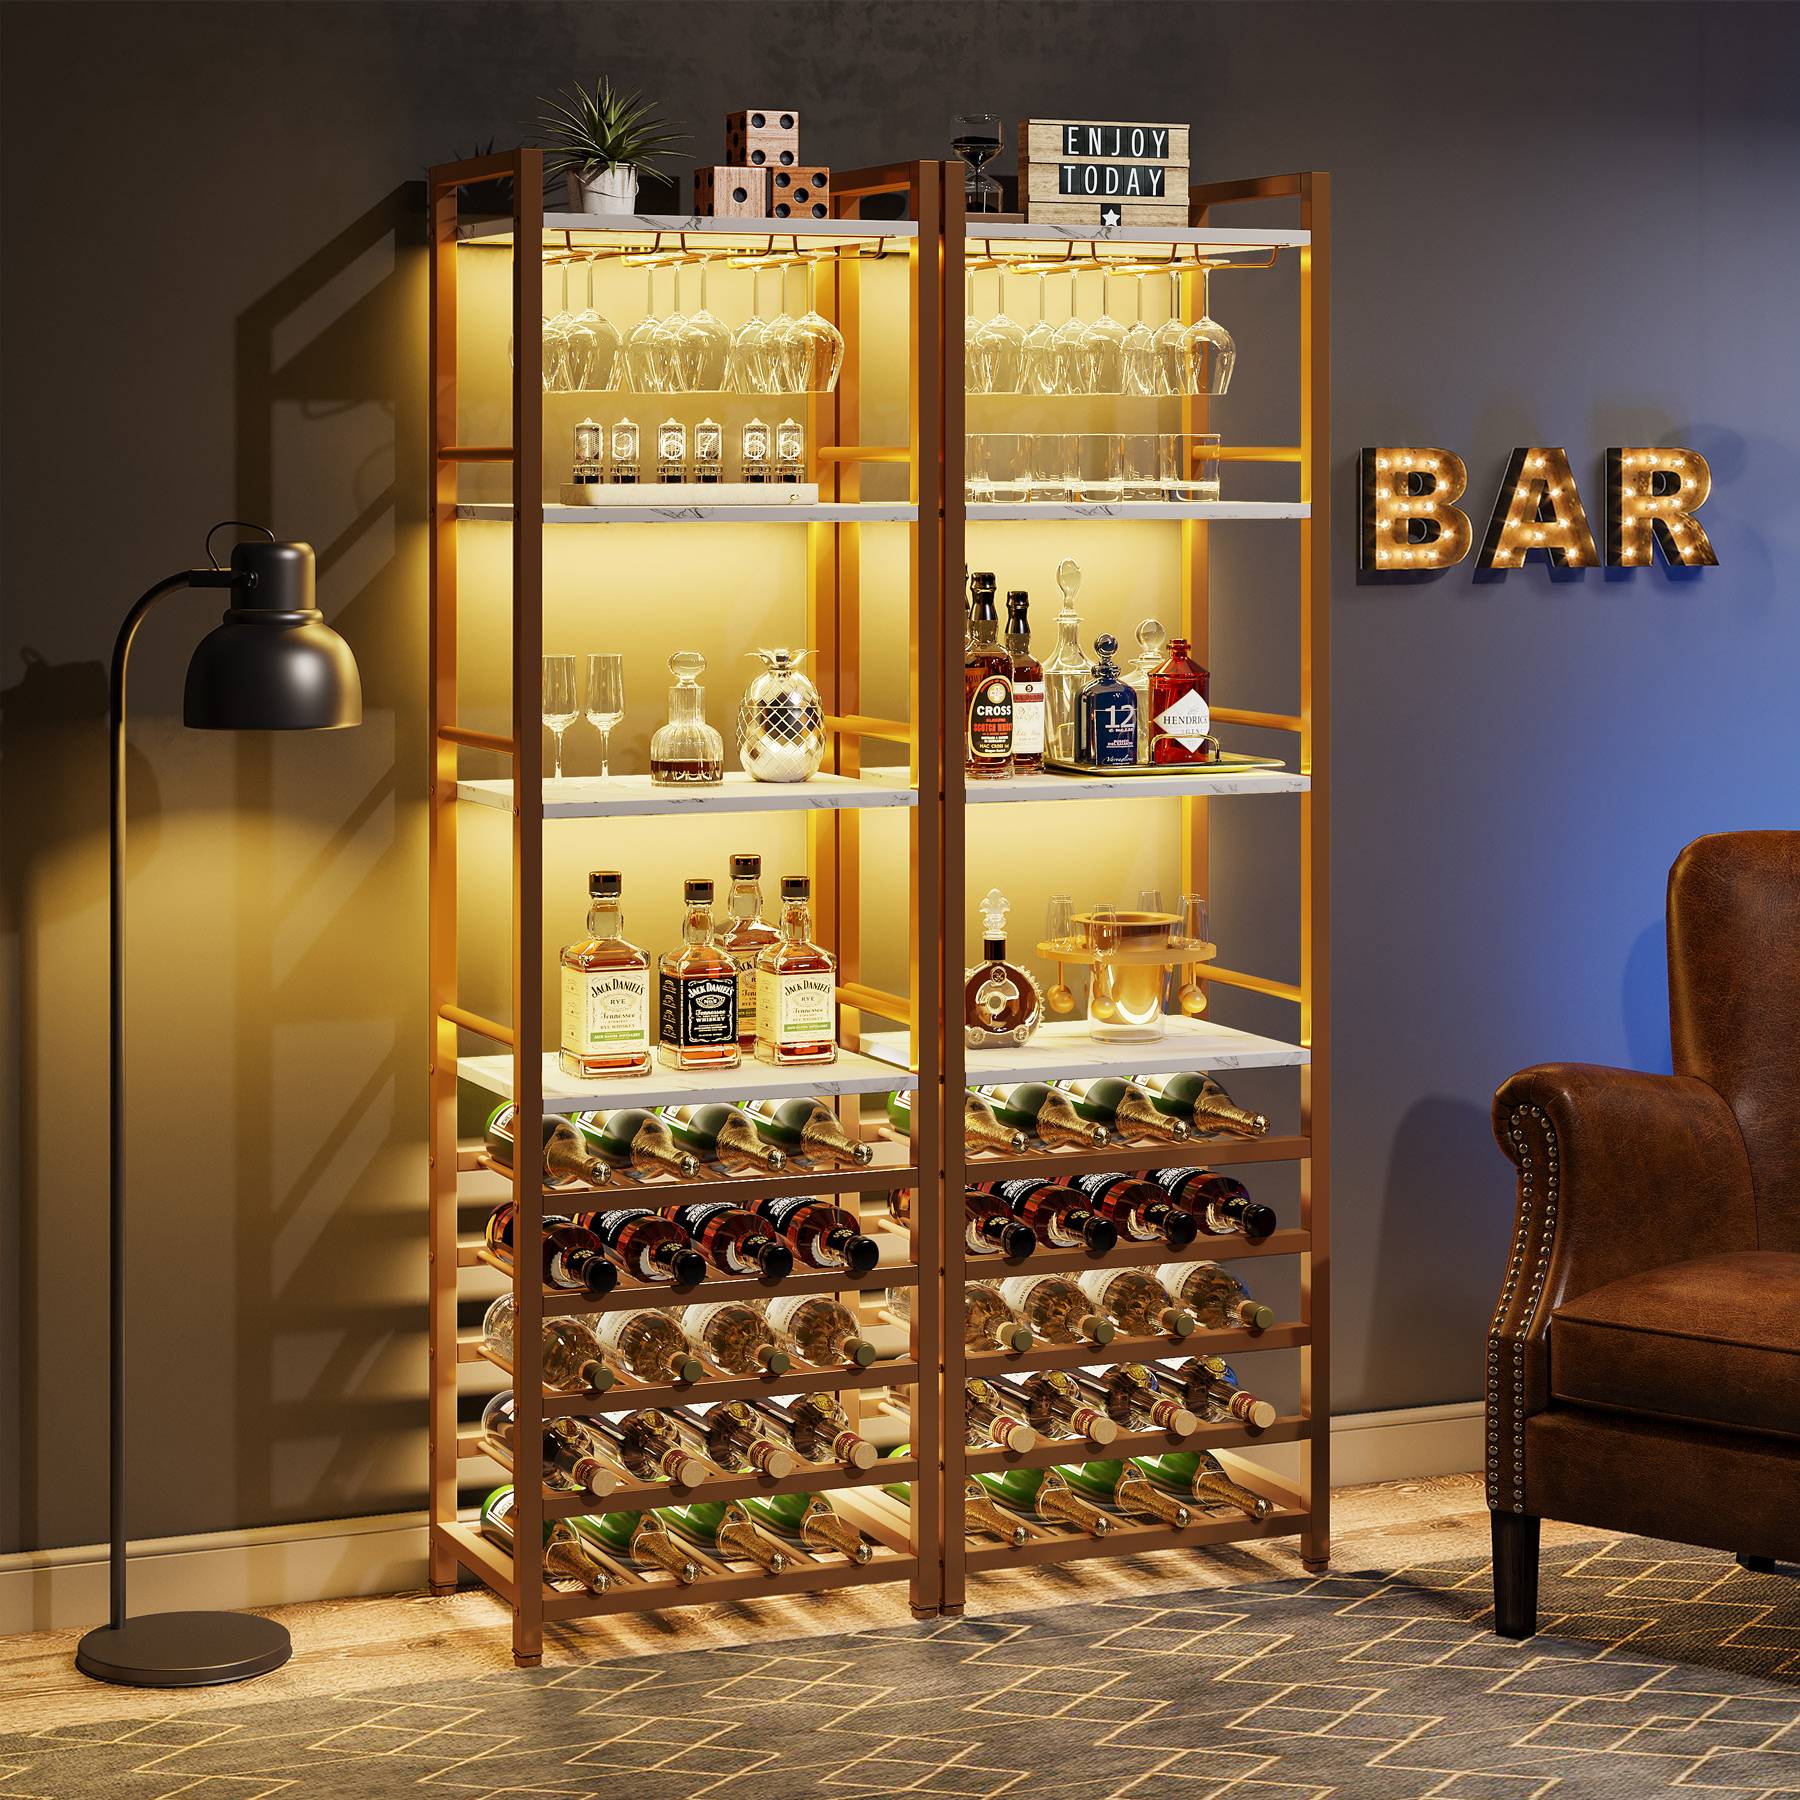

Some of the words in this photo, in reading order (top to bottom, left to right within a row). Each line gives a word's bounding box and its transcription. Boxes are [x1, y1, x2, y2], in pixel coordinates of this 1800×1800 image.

[1068, 126, 1165, 158] ENJOY
[1063, 165, 1162, 196] TODAY
[1360, 447, 1720, 570] BAR
[976, 705, 1012, 716] CROSS
[1105, 705, 1135, 728] 12
[590, 981, 612, 998] JACK
[612, 978, 645, 996] DANIEL'S
[688, 984, 707, 998] JACK
[706, 982, 735, 998] DANIEL'S
[785, 984, 803, 996] JACK
[803, 979, 832, 994] DANIEL'S
